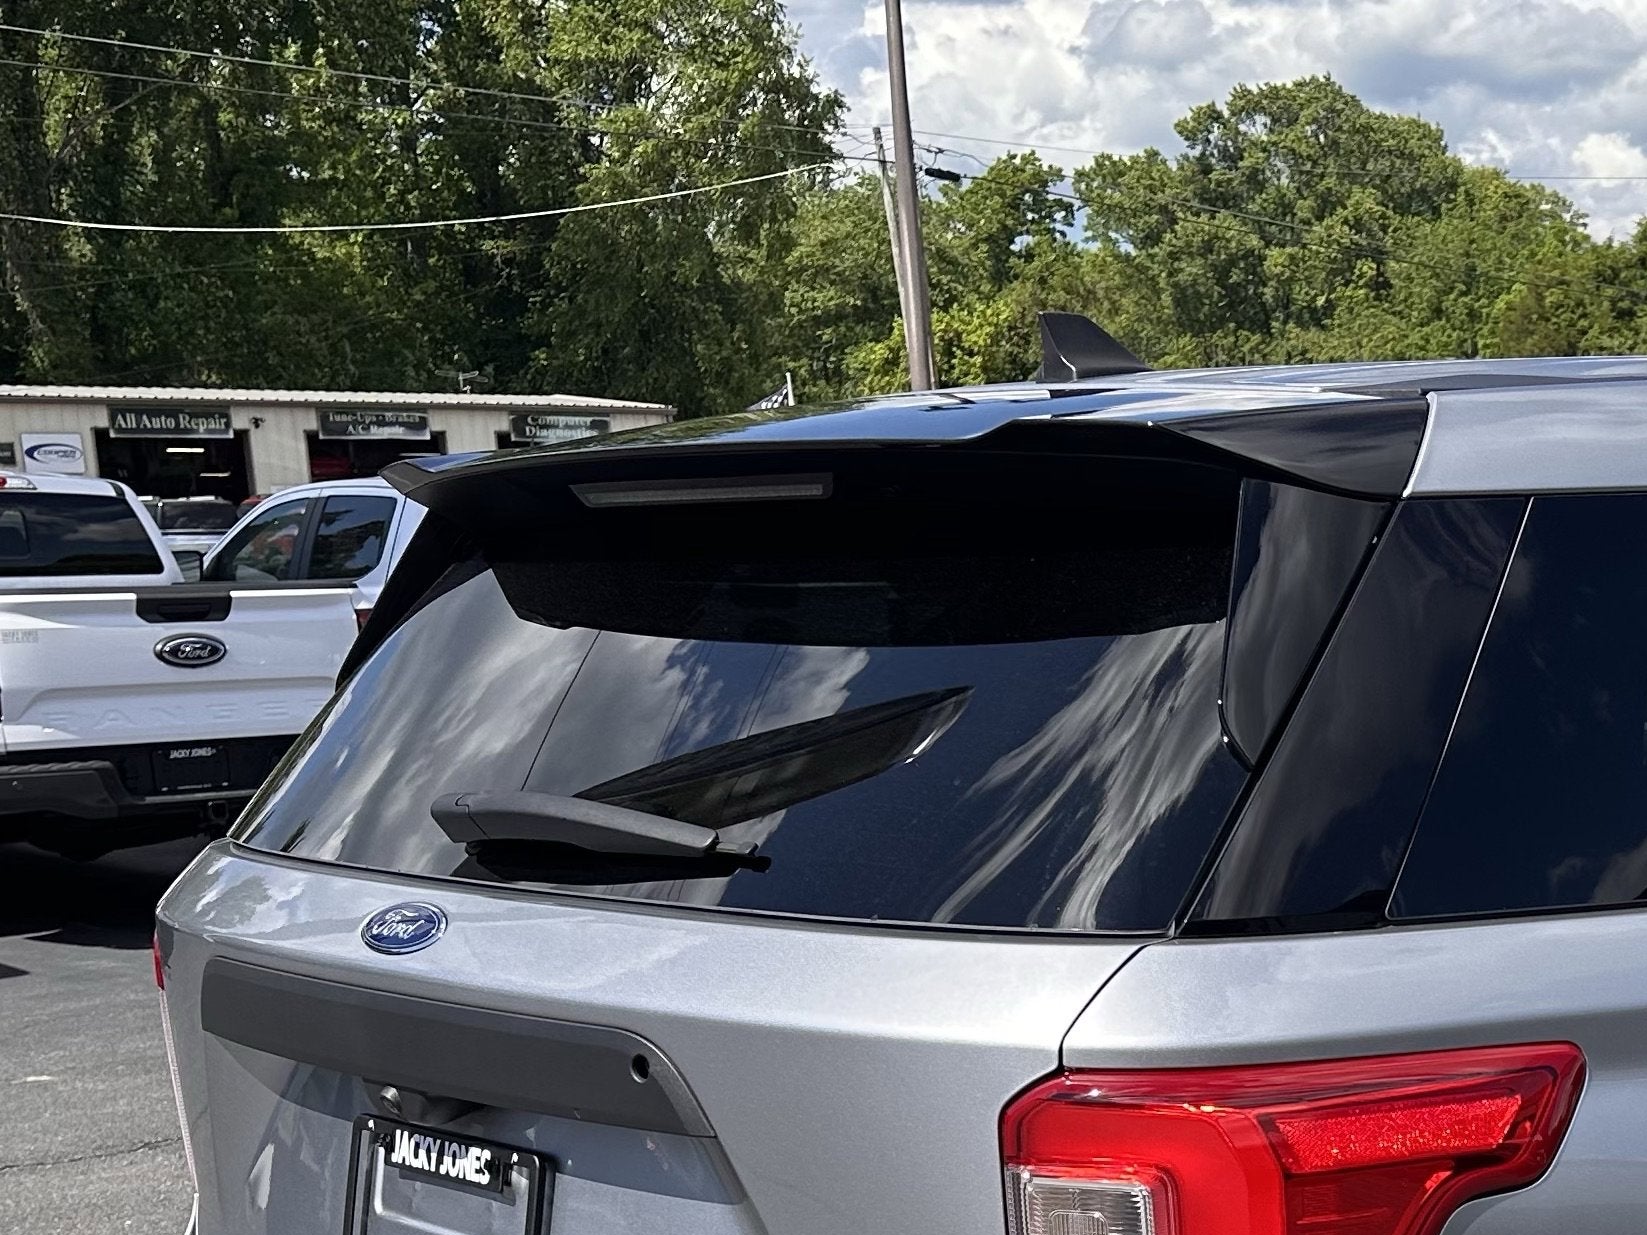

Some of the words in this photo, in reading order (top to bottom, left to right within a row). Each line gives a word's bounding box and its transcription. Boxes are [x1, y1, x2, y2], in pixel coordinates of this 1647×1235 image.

[114, 413, 136, 429] All
[140, 413, 176, 429] Auto
[179, 413, 228, 433] Repair
[526, 415, 591, 428] Computer
[177, 643, 212, 658] Ford
[371, 908, 425, 940] Ford
[390, 1129, 442, 1173] JACKY
[439, 1140, 492, 1185] JONES
